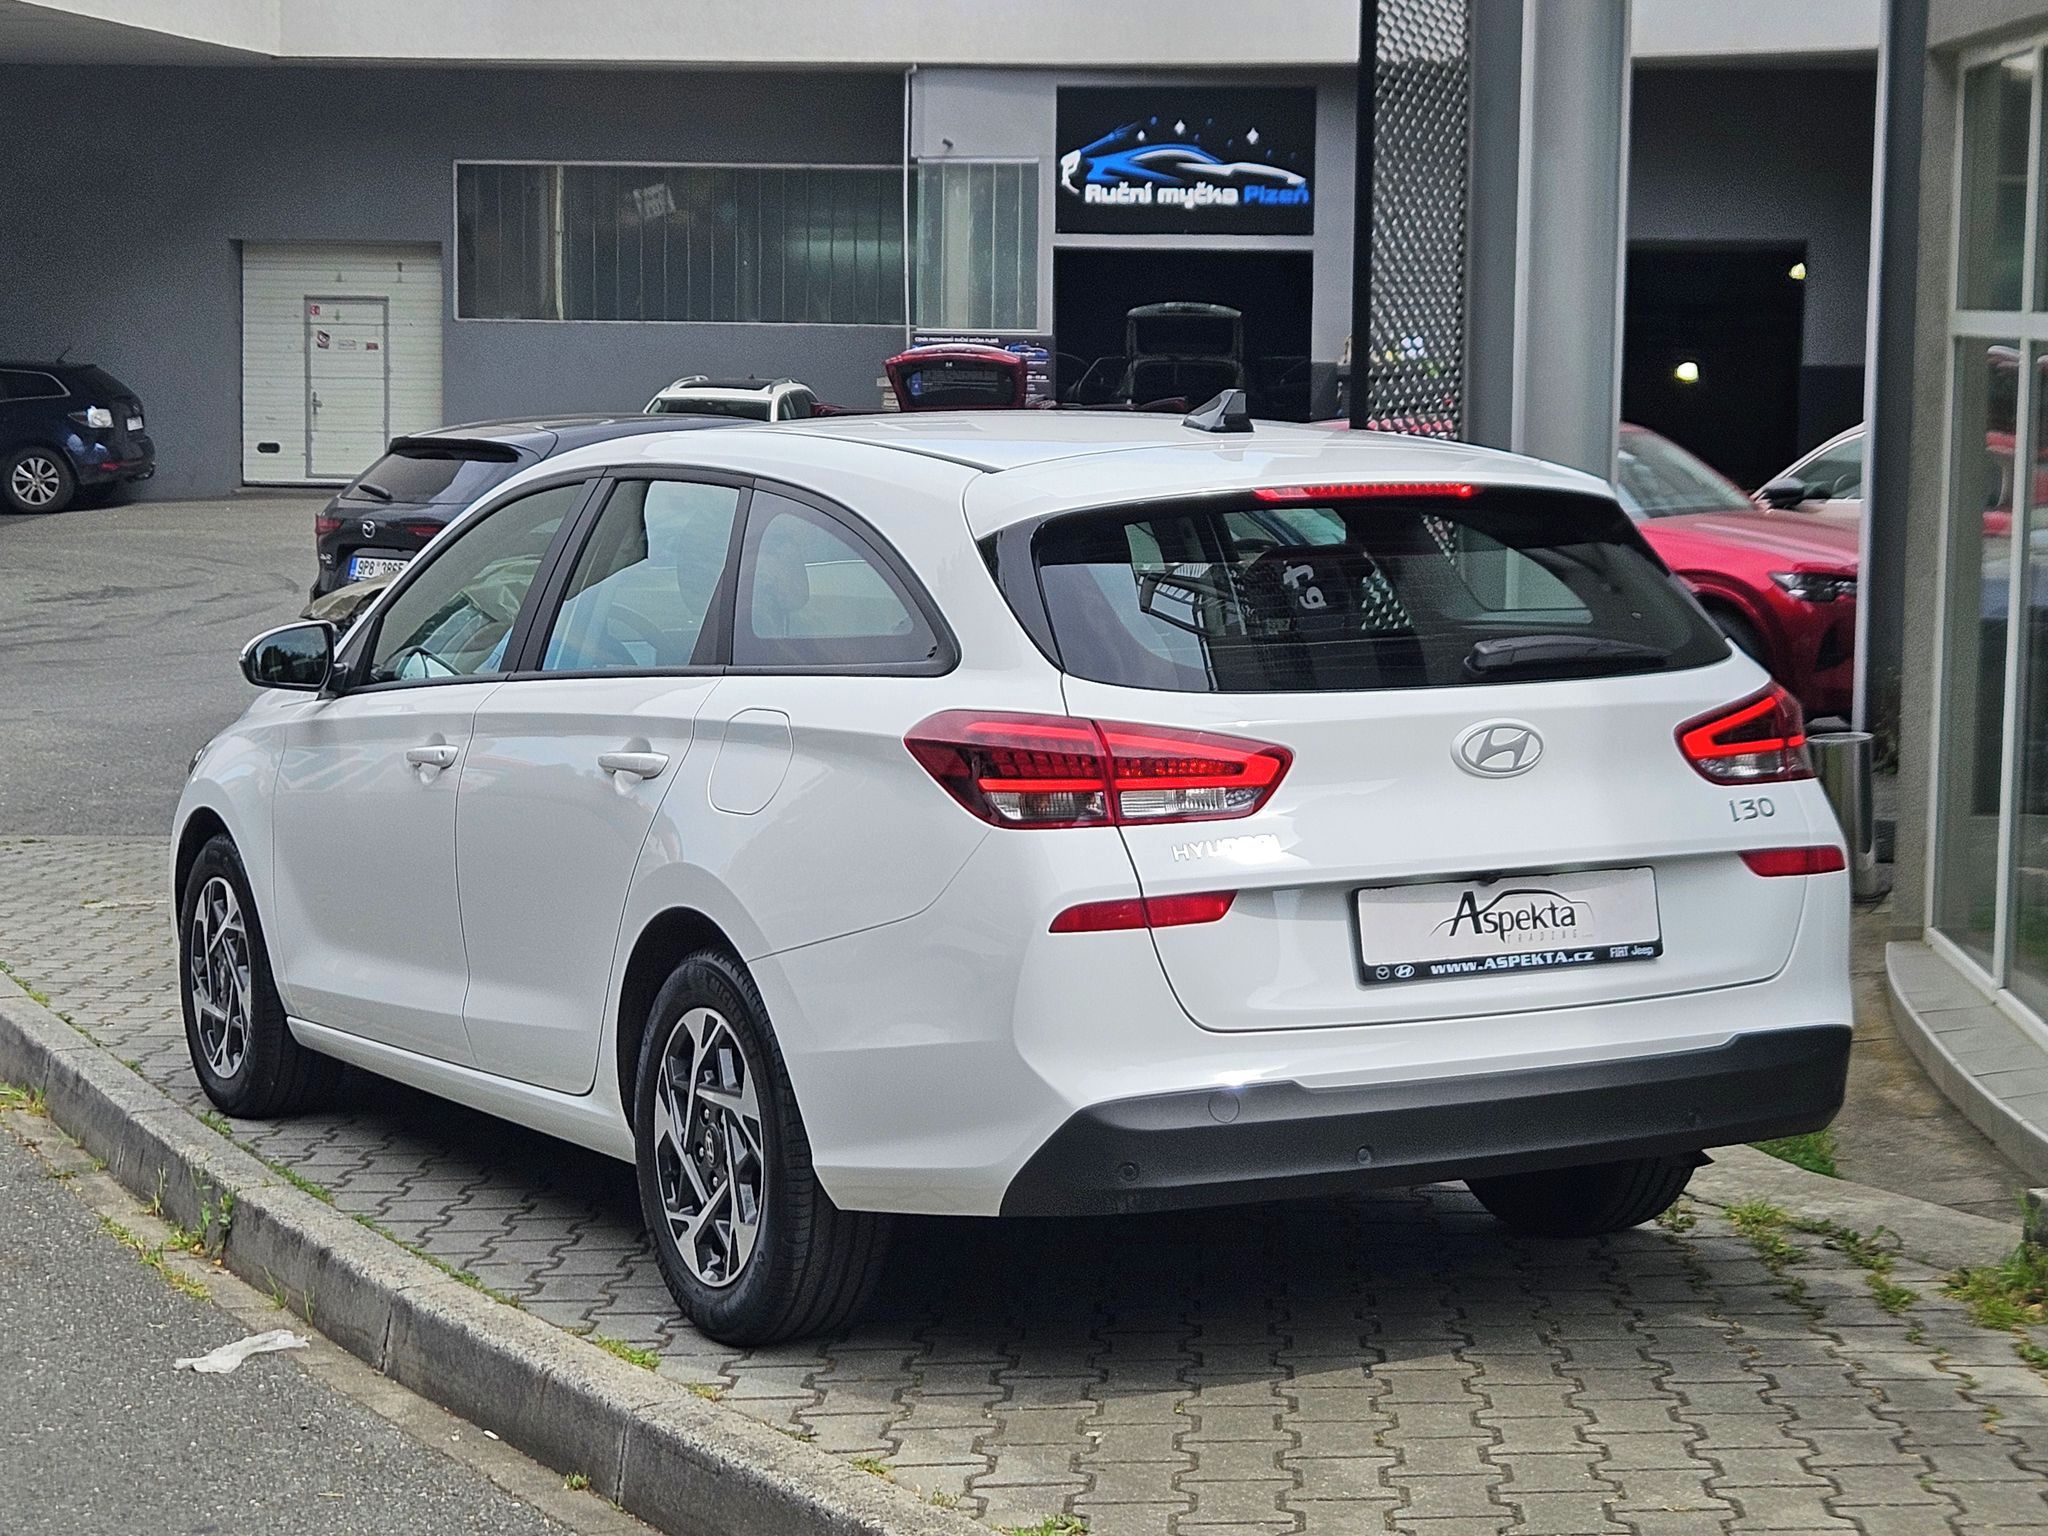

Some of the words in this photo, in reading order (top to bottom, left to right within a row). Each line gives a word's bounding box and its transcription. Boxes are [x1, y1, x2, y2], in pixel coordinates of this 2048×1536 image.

[1084, 182, 1152, 204] Ruční
[1157, 181, 1239, 209] myčka
[1243, 183, 1309, 204] Plzeň
[1172, 833, 1281, 862] HYUAI
[1449, 891, 1576, 943] Aspekta
[1631, 945, 1654, 957] Jeep
